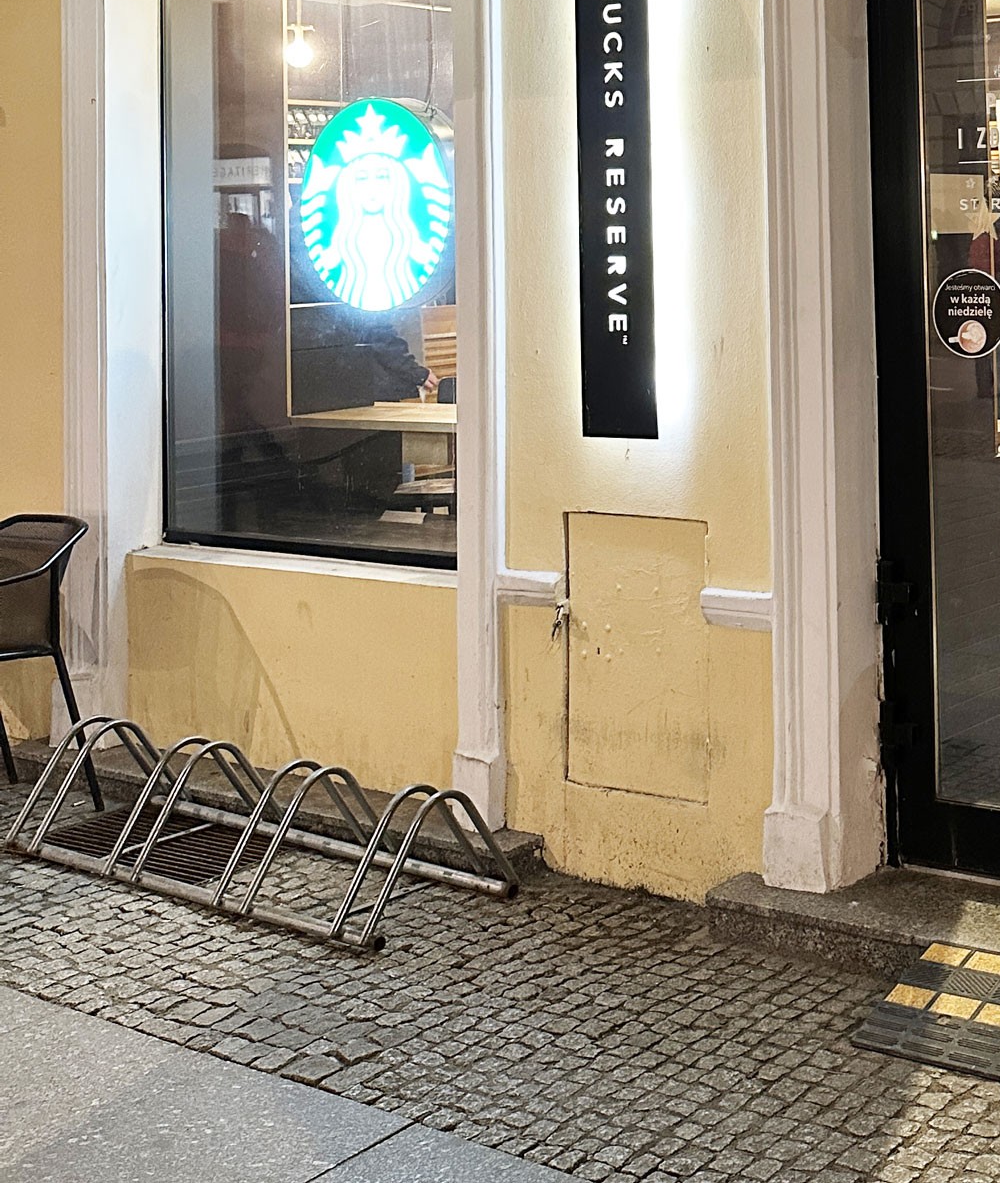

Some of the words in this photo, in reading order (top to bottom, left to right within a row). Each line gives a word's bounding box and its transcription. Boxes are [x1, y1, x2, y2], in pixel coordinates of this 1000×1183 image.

[957, 128, 963, 150] I
[945, 284, 973, 292] Jesteśmy
[950, 296, 959, 304] w
[961, 293, 991, 307] każdą
[948, 306, 993, 319] niedzielę
